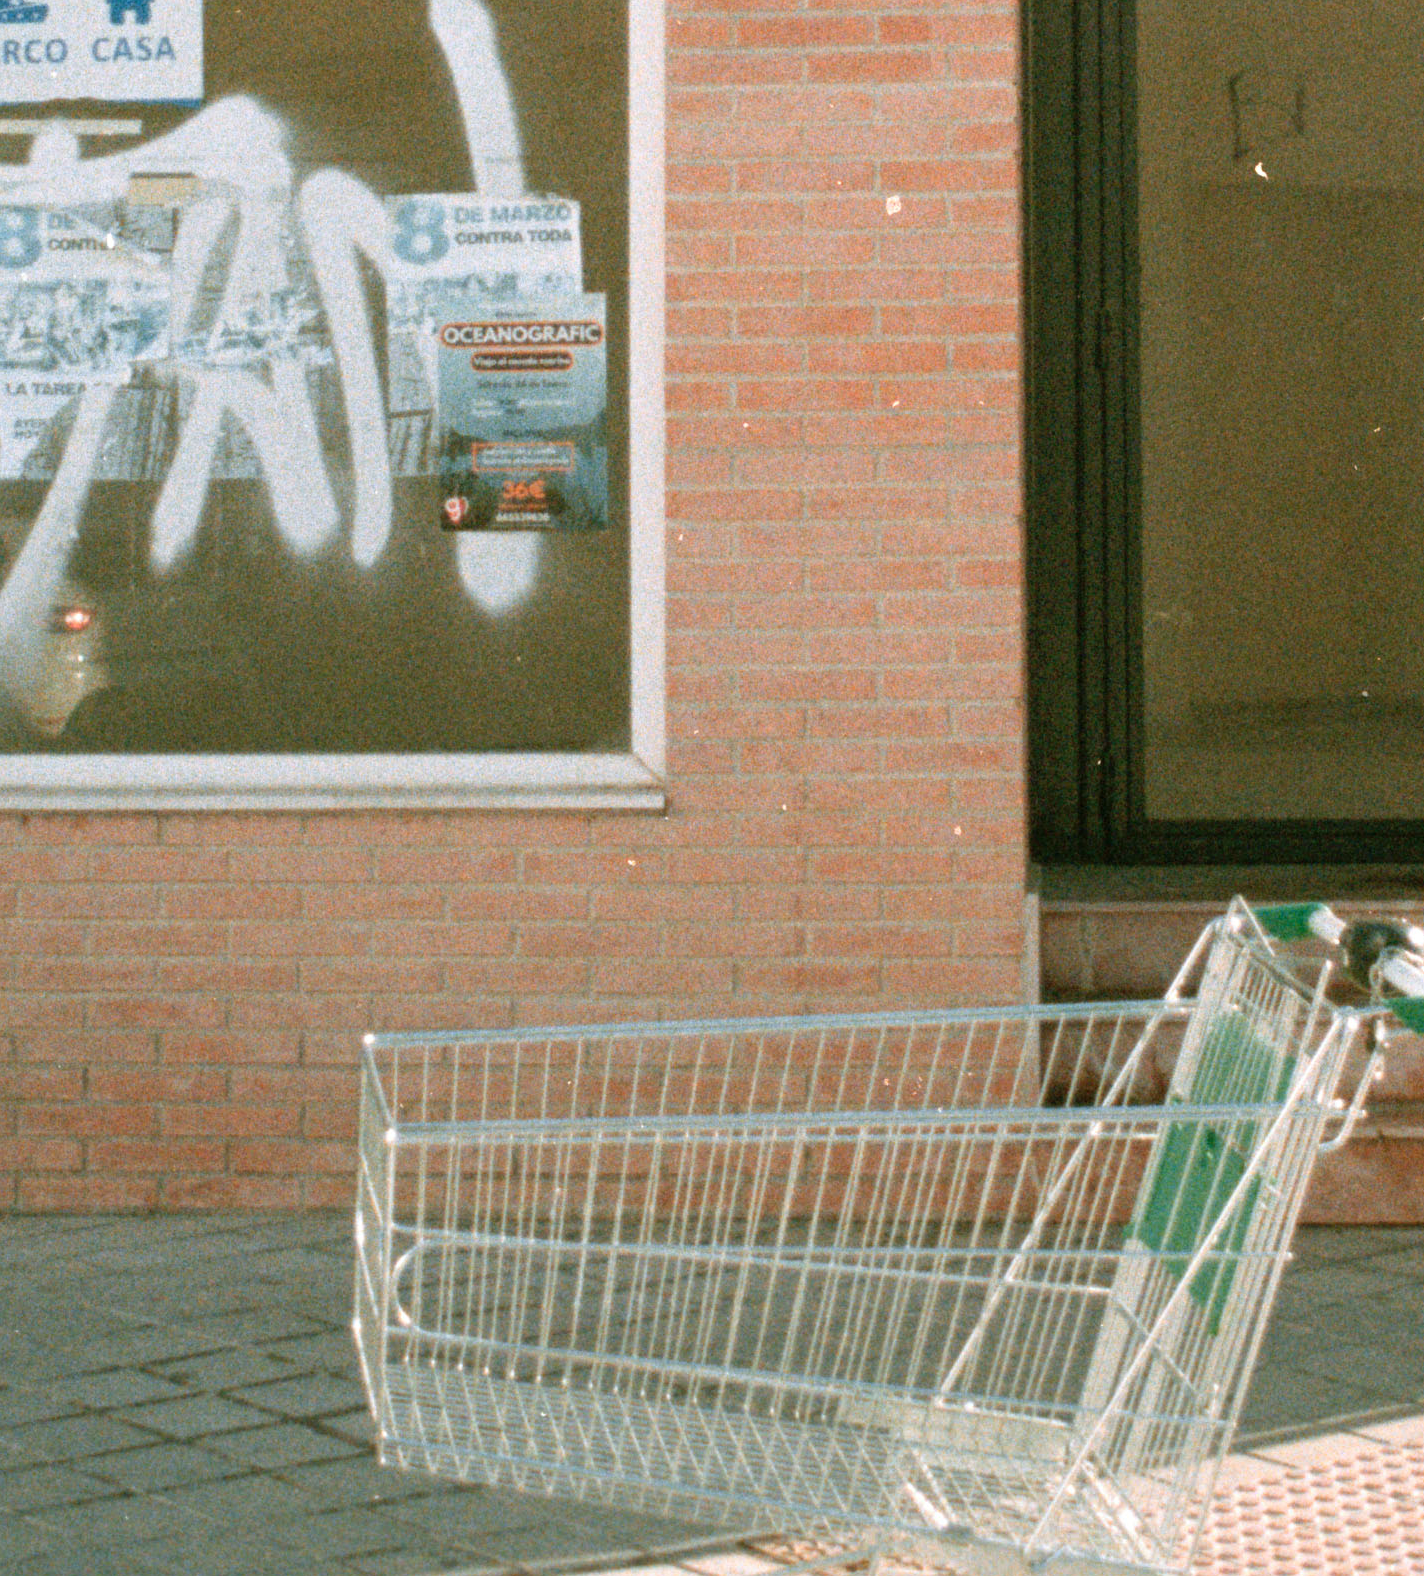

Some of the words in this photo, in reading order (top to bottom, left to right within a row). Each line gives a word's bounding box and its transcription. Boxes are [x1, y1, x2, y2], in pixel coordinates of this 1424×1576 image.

[92, 36, 176, 62] CASA
[393, 200, 450, 266] 8
[455, 206, 483, 223] DE
[490, 204, 571, 222] MARZO
[455, 231, 523, 245] CONTRA
[527, 229, 572, 242] TODA
[444, 325, 599, 343] OCEANOGRAFIC
